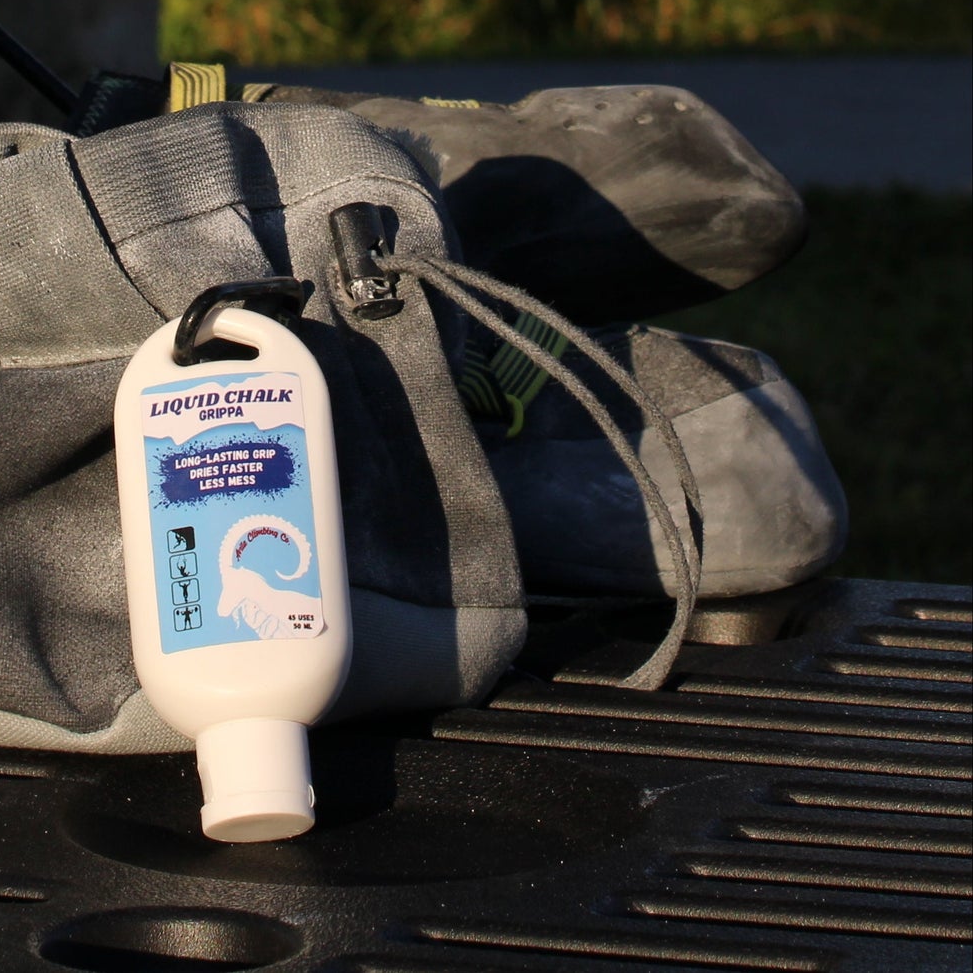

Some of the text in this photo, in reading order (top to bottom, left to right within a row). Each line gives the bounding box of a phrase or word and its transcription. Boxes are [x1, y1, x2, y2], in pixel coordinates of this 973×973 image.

[150, 389, 293, 417] LIQUID CHALK
[199, 405, 244, 421] GRIPPA
[175, 449, 276, 469] LONG-LASTING GRIP
[190, 462, 263, 479] DRIES FASTER
[199, 475, 256, 490] LESS MESS
[297, 614, 314, 622] USES
